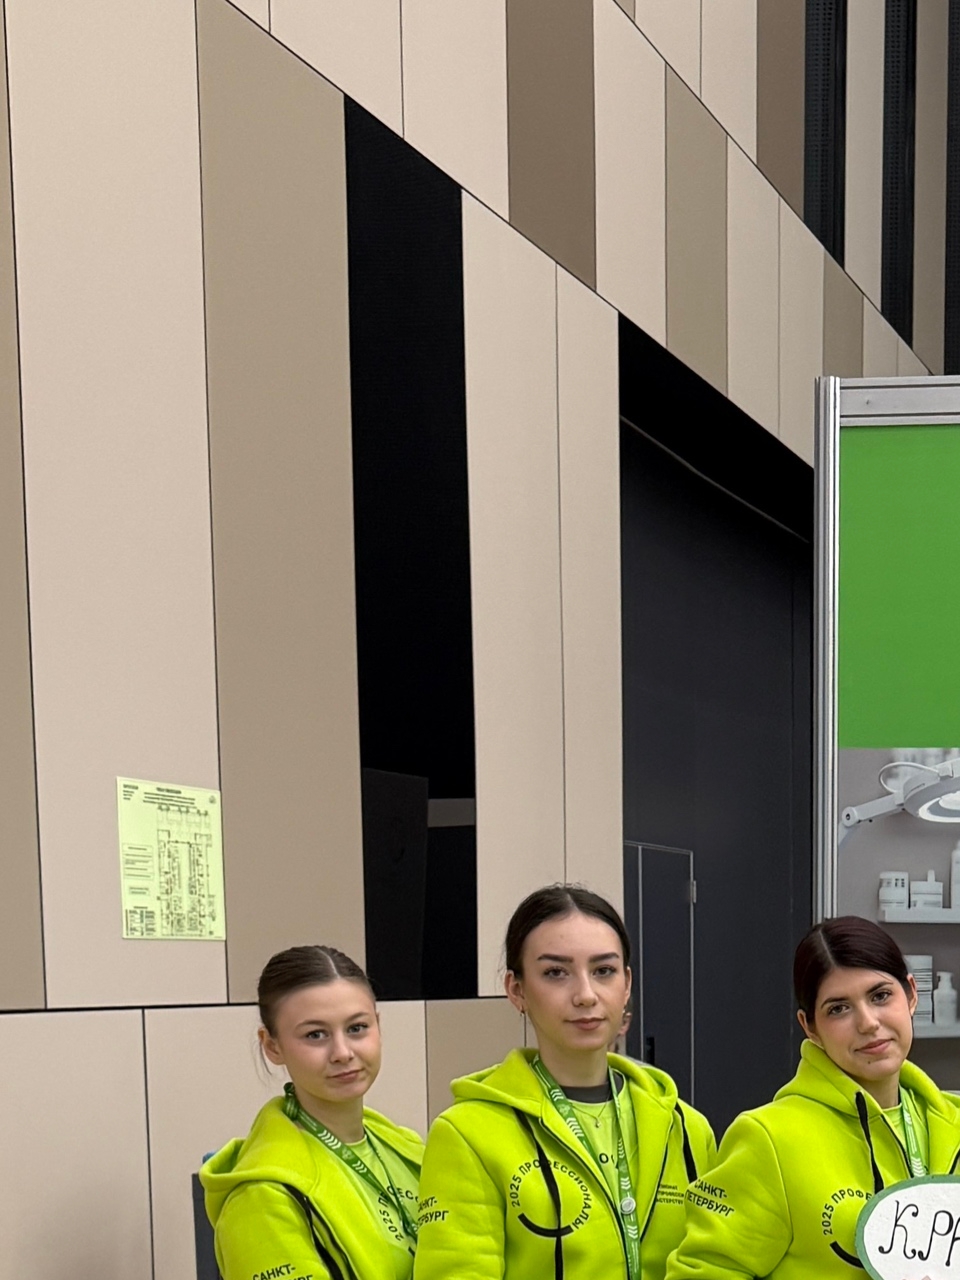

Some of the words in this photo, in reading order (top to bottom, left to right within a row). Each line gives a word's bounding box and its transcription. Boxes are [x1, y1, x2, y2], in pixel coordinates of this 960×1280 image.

[510, 1174, 522, 1208] 2025
[518, 1158, 593, 1230] ПРОЕССИОНАЛЫ
[821, 1203, 835, 1236] 2025
